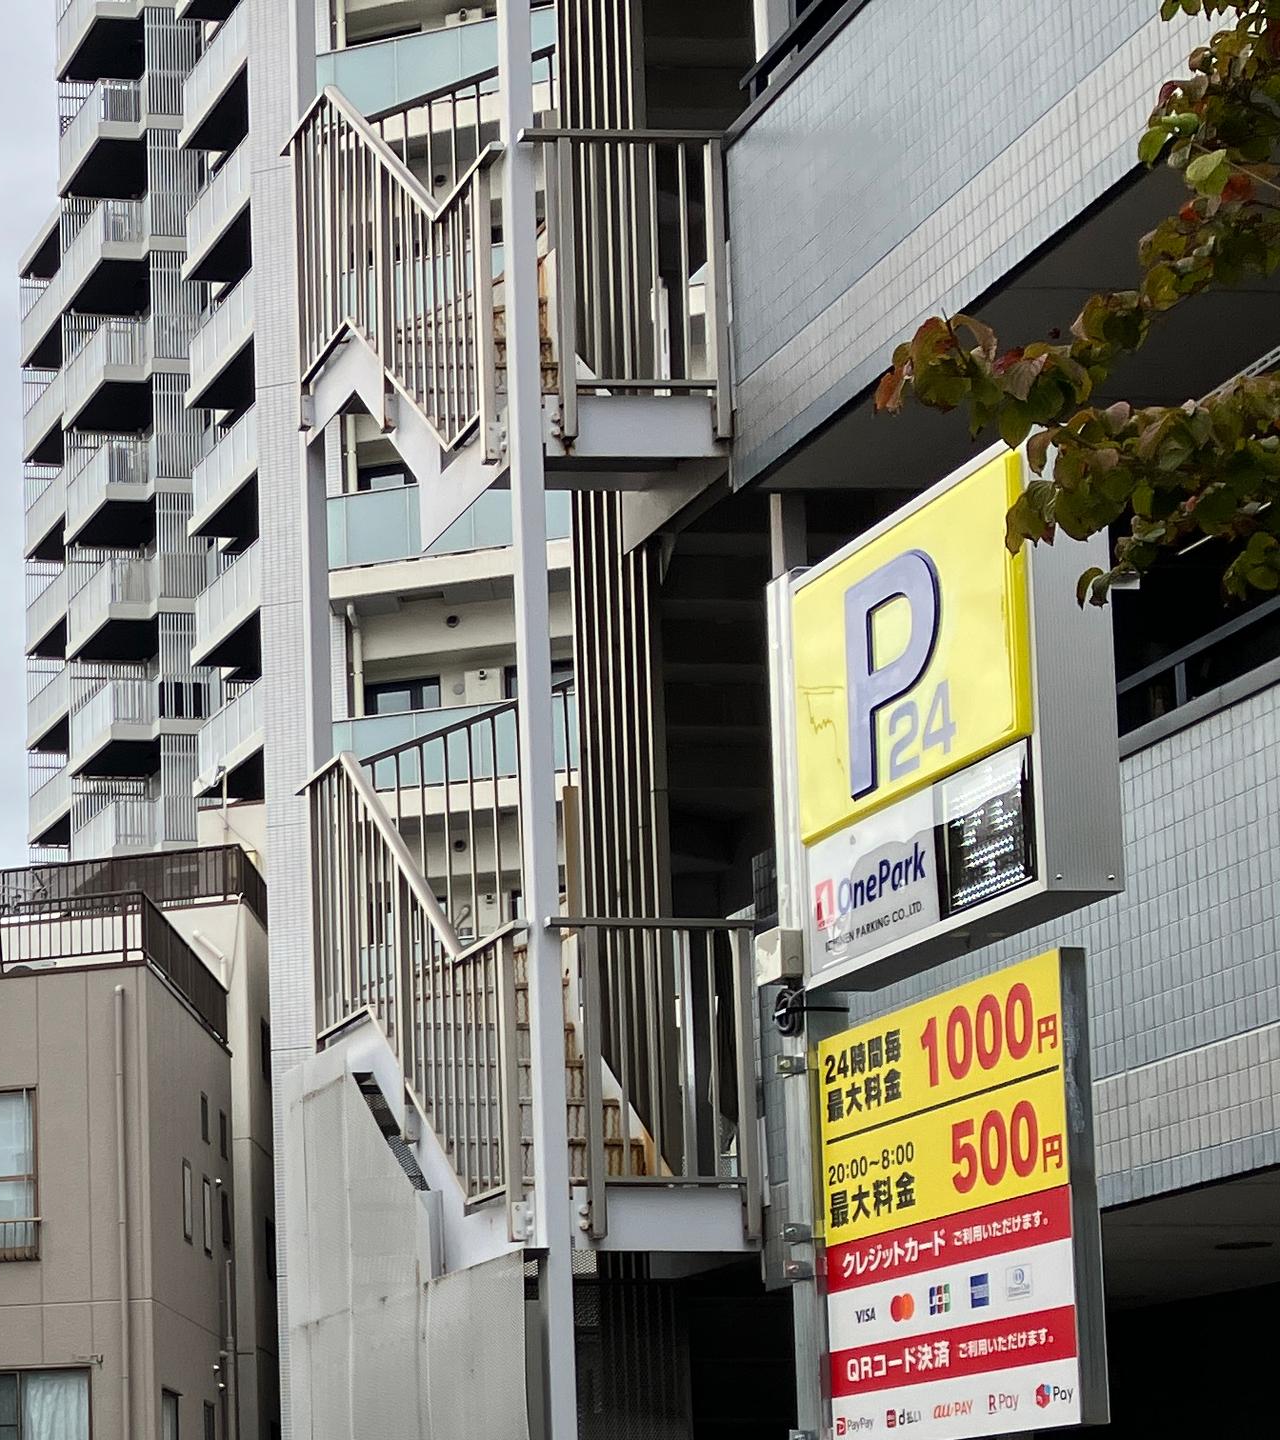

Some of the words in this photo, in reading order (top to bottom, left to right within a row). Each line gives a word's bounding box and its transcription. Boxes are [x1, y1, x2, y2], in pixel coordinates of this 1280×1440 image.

[845, 549, 941, 800] P
[889, 679, 956, 781] 24
[838, 842, 926, 916] OnePark
[856, 915, 890, 940] PARKING
[825, 1029, 902, 1086] 24時間毎
[920, 982, 1058, 1089] 1000円
[827, 1069, 903, 1123] 最大料金
[951, 1100, 1063, 1195] 500円
[830, 1172, 916, 1229] 最大料金
[842, 1229, 946, 1278] クレジットカード
[953, 1210, 1050, 1246] ご利用いただけます。
[855, 1308, 877, 1324] VISA
[847, 1340, 950, 1382] QRコード決済
[959, 1328, 1054, 1359] ご利用いただけます。
[954, 1400, 973, 1416] PAY
[1053, 1385, 1073, 1404] Pay
[848, 1416, 874, 1433] PayPay
